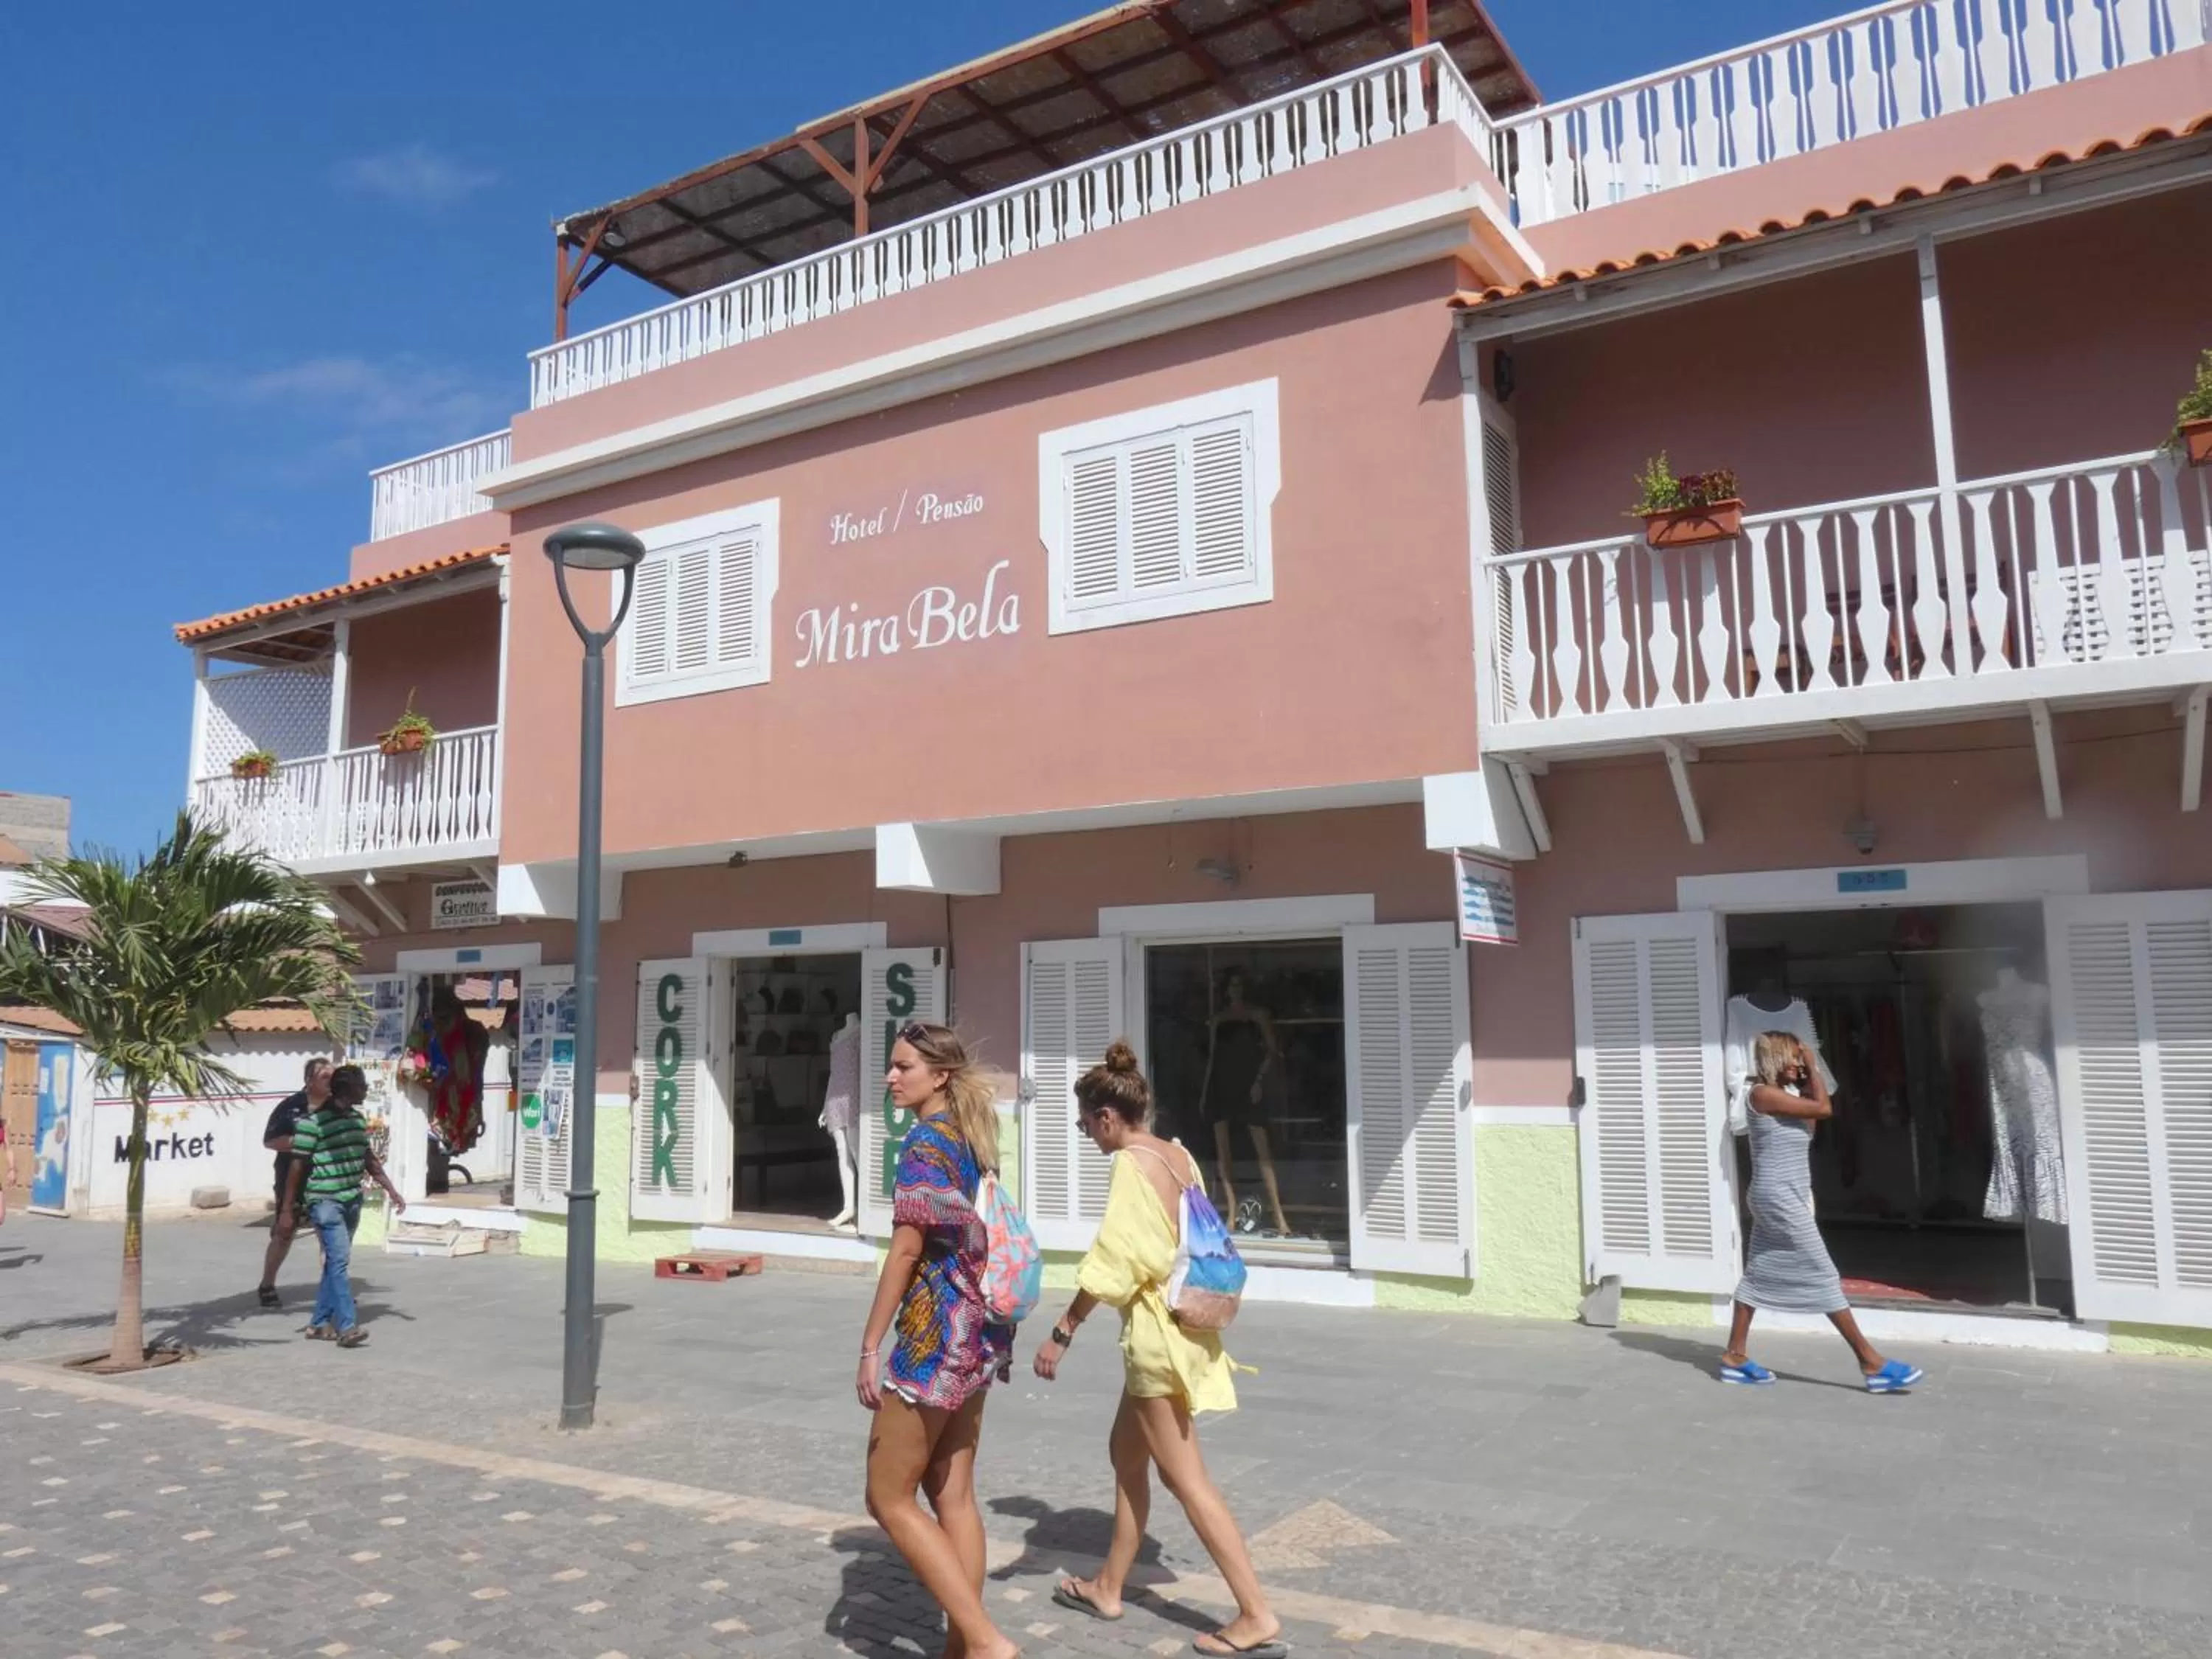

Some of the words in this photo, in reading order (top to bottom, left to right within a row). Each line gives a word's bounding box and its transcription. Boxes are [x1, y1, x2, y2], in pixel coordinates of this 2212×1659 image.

[830, 507, 888, 545] Hotel
[916, 492, 984, 524] Pensão
[652, 973, 684, 1188] CORK
